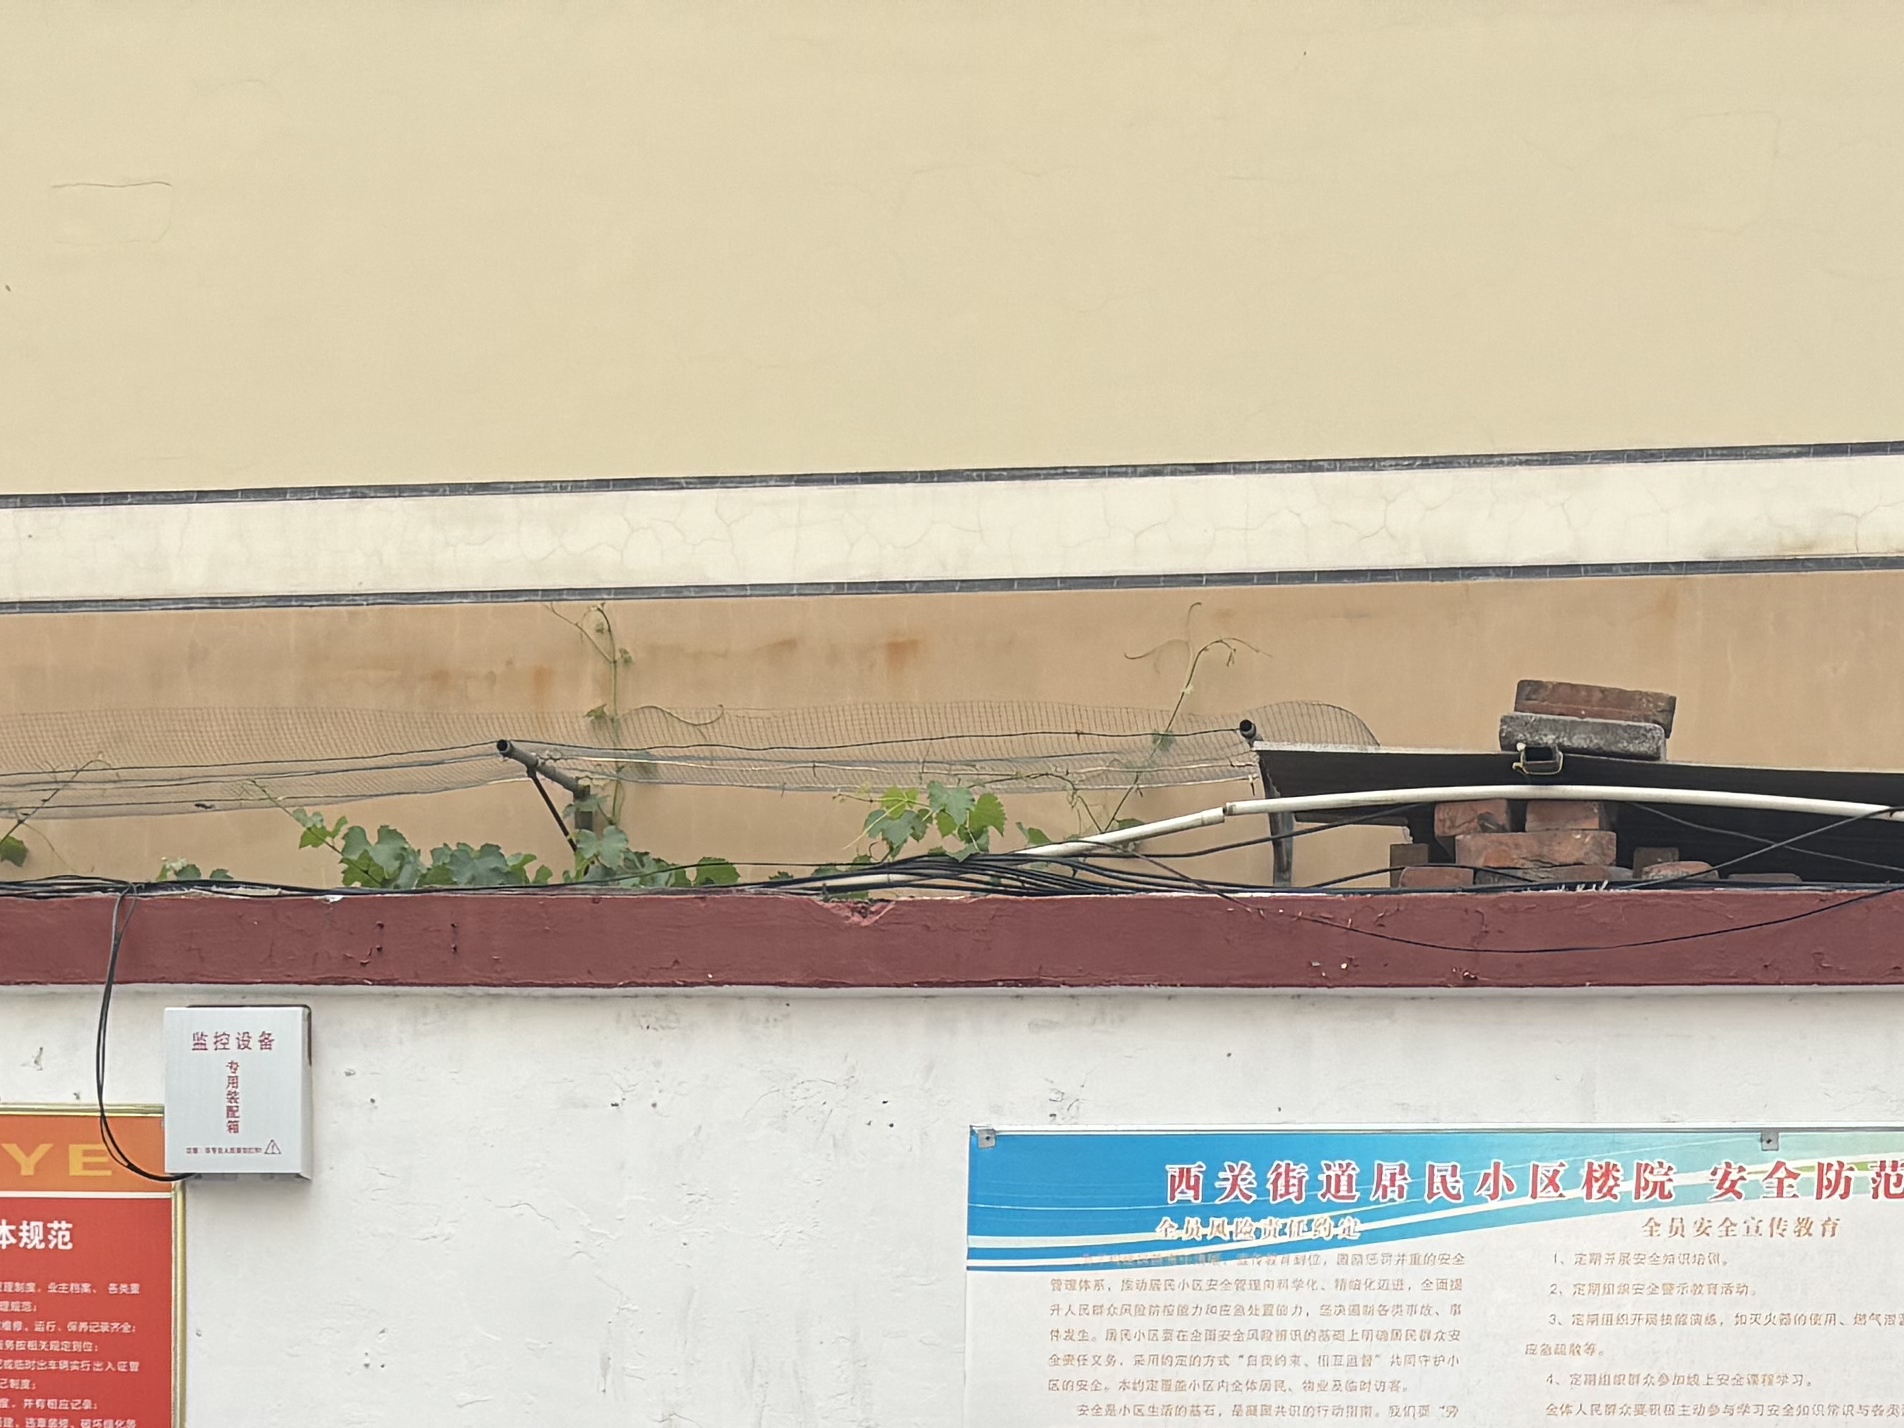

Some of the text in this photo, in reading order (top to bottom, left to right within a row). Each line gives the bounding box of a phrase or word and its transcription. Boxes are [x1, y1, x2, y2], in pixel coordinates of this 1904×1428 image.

[192, 1030, 275, 1051] 监控设备
[225, 1060, 241, 1134] 专用装配箱
[6, 1143, 115, 1178] YE
[1165, 1160, 1678, 1205] 西关街道居民小区楼院
[1155, 1217, 1363, 1240] 全员风险责任约定
[1641, 1215, 1842, 1239] 全员安全宣传教育
